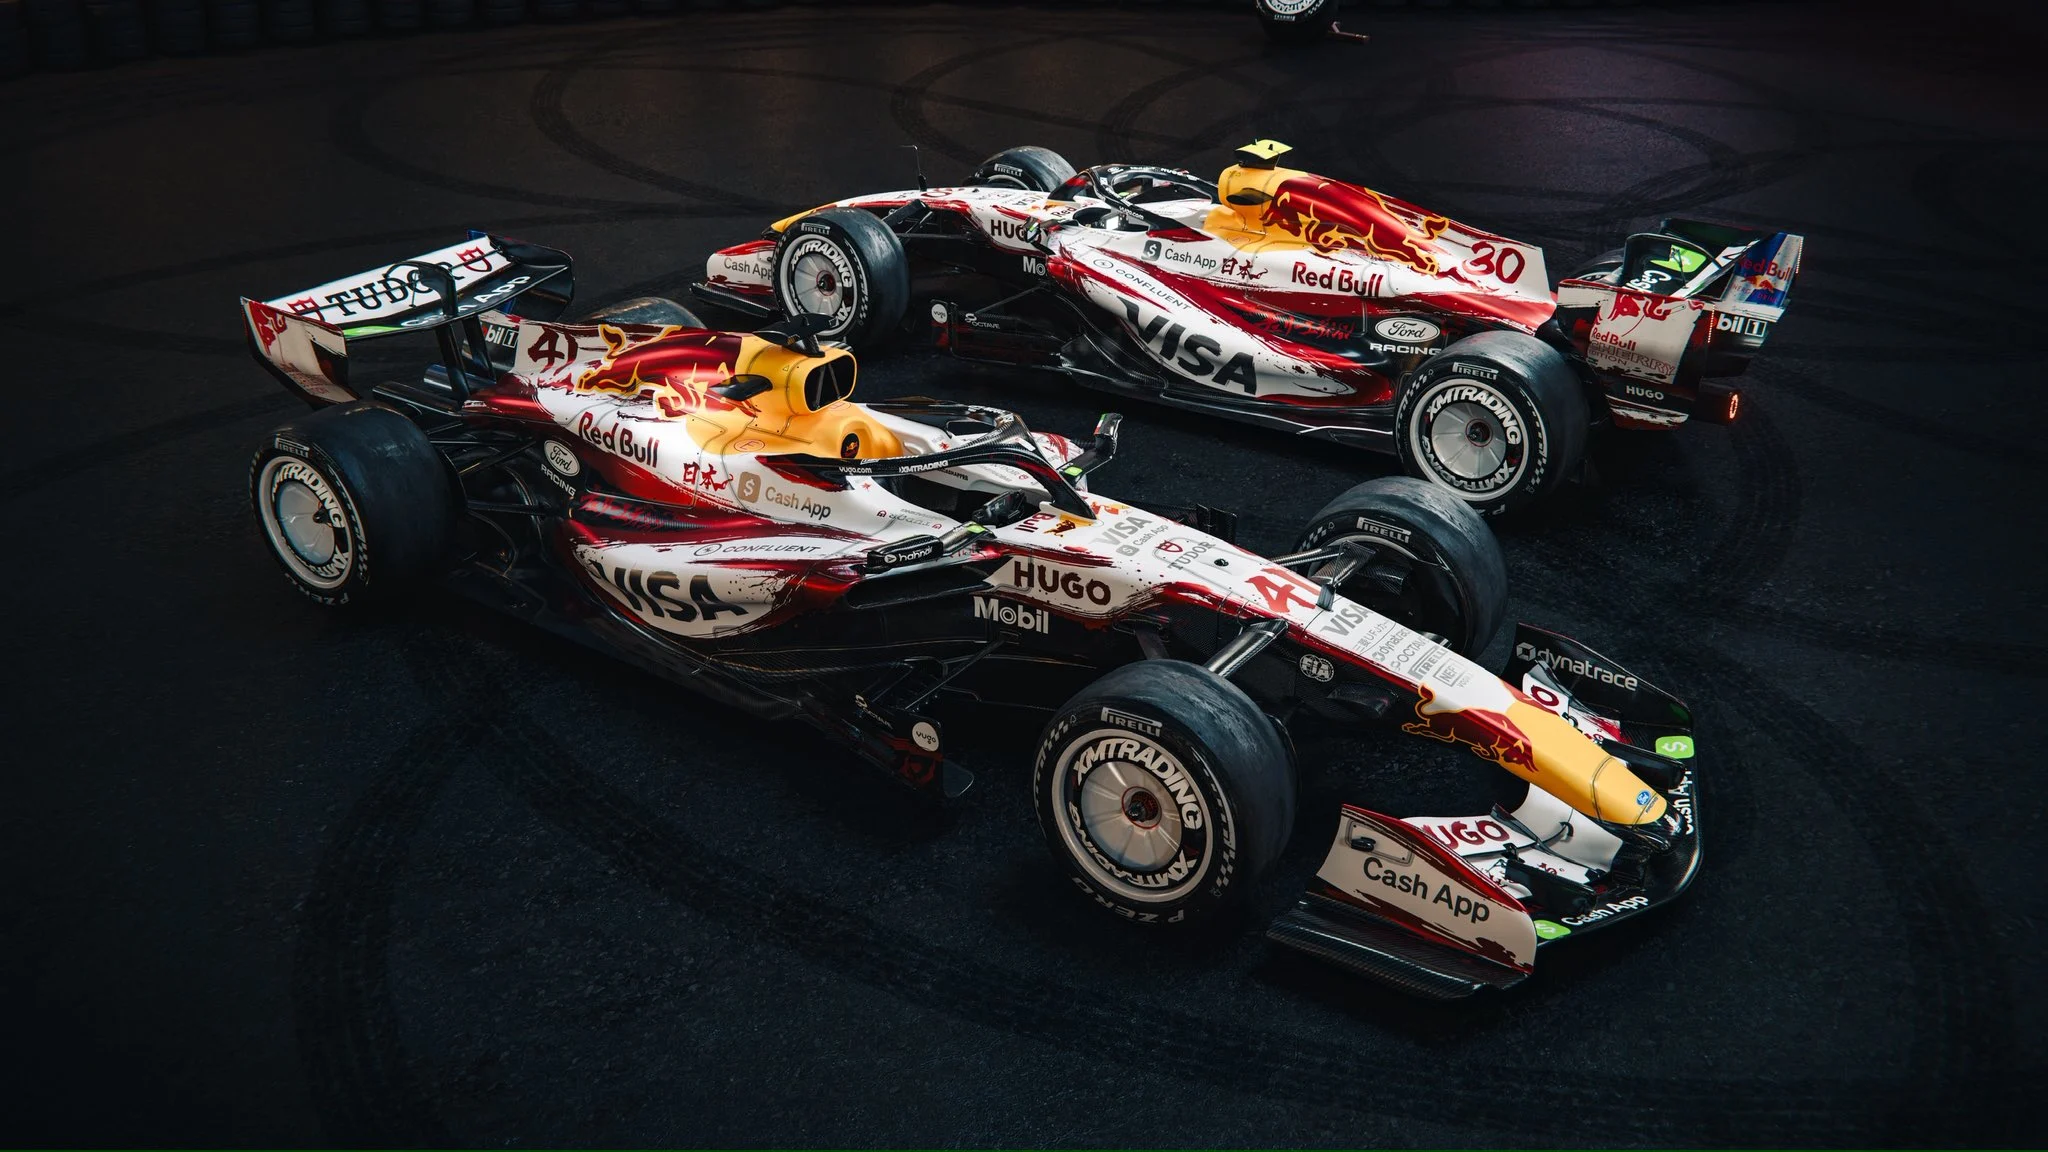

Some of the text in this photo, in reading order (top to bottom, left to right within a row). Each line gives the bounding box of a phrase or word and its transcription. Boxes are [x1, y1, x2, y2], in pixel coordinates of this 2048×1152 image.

[994, 163, 1024, 178] PIRELLI
[801, 223, 830, 235] PIRELLI
[724, 257, 750, 274] Cash
[790, 239, 853, 288] XMTRADING
[1164, 248, 1217, 269] Cash App
[1462, 240, 1526, 284] 30
[472, 275, 531, 305] App
[1116, 268, 1192, 310] CONFLUENT
[1292, 261, 1383, 298] Red Bull
[1388, 317, 1425, 339] Ford
[1591, 326, 1637, 351] Red Bull
[527, 326, 578, 376] 41
[1117, 295, 1257, 395] VISA
[1370, 342, 1443, 356] RACING
[1590, 340, 1676, 376] CHERRY
[1452, 361, 1499, 381] PIRELLI
[1626, 385, 1665, 401] HUGO
[1426, 385, 1522, 446] XMTRADING
[578, 411, 660, 469] Red Bull
[549, 445, 573, 473] Ford
[900, 460, 949, 474] XMTRADING
[540, 463, 577, 498] RACING
[765, 486, 832, 521] Cash App
[1090, 516, 1152, 547] VISA
[1133, 524, 1169, 547] Cash App
[1356, 516, 1411, 544] PIRELLI
[722, 544, 822, 554] CONFLUENT
[1167, 541, 1217, 571] TUDOR
[585, 559, 749, 623] VISA
[1014, 560, 1112, 606] HUGO
[1244, 568, 1321, 613] 41
[973, 596, 1049, 635] Mobil
[1320, 604, 1375, 637] VISA
[1407, 645, 1450, 681] PIRELLI
[1536, 648, 1638, 692] dynatrace
[916, 730, 936, 745] vugo
[1101, 706, 1163, 738] PIRELLI
[1072, 738, 1203, 831] XMTRADING
[1068, 801, 1198, 889] XMTRADING
[1421, 819, 1510, 850] UGO
[1363, 856, 1490, 923] Cash App
[1560, 894, 1650, 927] Cash App
